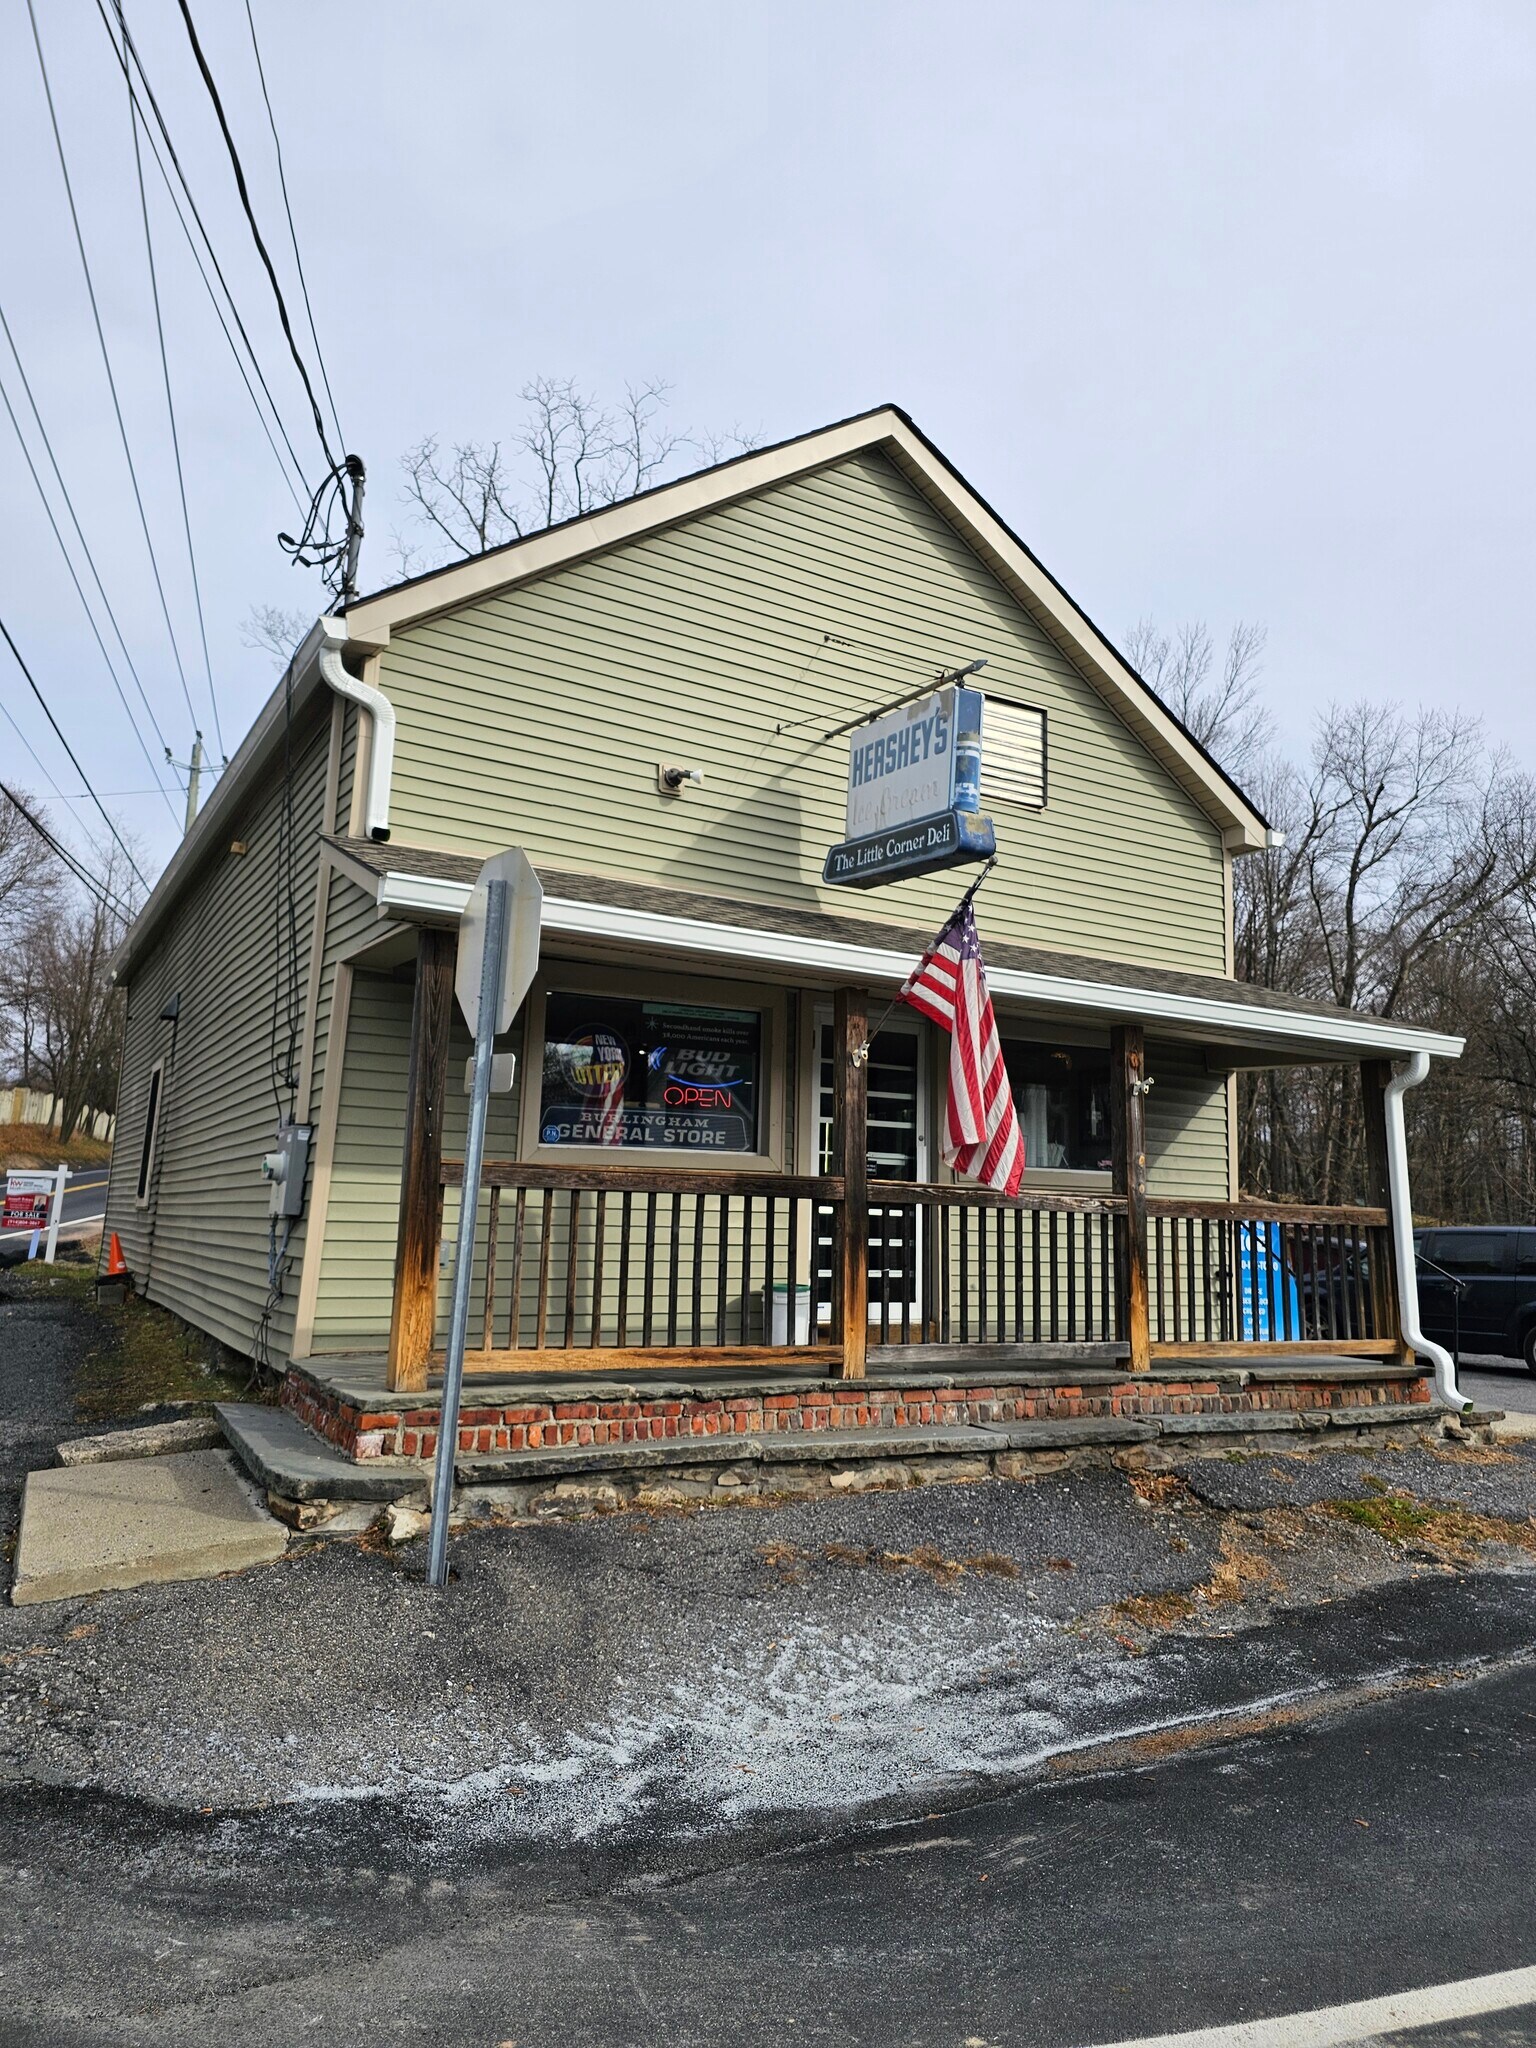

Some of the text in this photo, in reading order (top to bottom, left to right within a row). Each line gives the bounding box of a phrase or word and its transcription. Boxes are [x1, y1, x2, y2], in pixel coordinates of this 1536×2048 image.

[852, 707, 948, 788] HERSHEY'S
[834, 823, 951, 872] The Little Corner Deli
[662, 1022, 701, 1033] Secondhand
[702, 1026, 722, 1034] smoke
[723, 1026, 736, 1035] kills
[595, 1034, 616, 1046] NEW
[686, 1033, 720, 1042] Americans
[720, 1035, 735, 1043] each
[676, 1048, 731, 1063] BUD
[664, 1061, 740, 1078] LIGHT
[663, 1086, 732, 1108] OPEN
[580, 1112, 709, 1128] BURLINGHAM
[557, 1123, 726, 1145] GENERAL STORE
